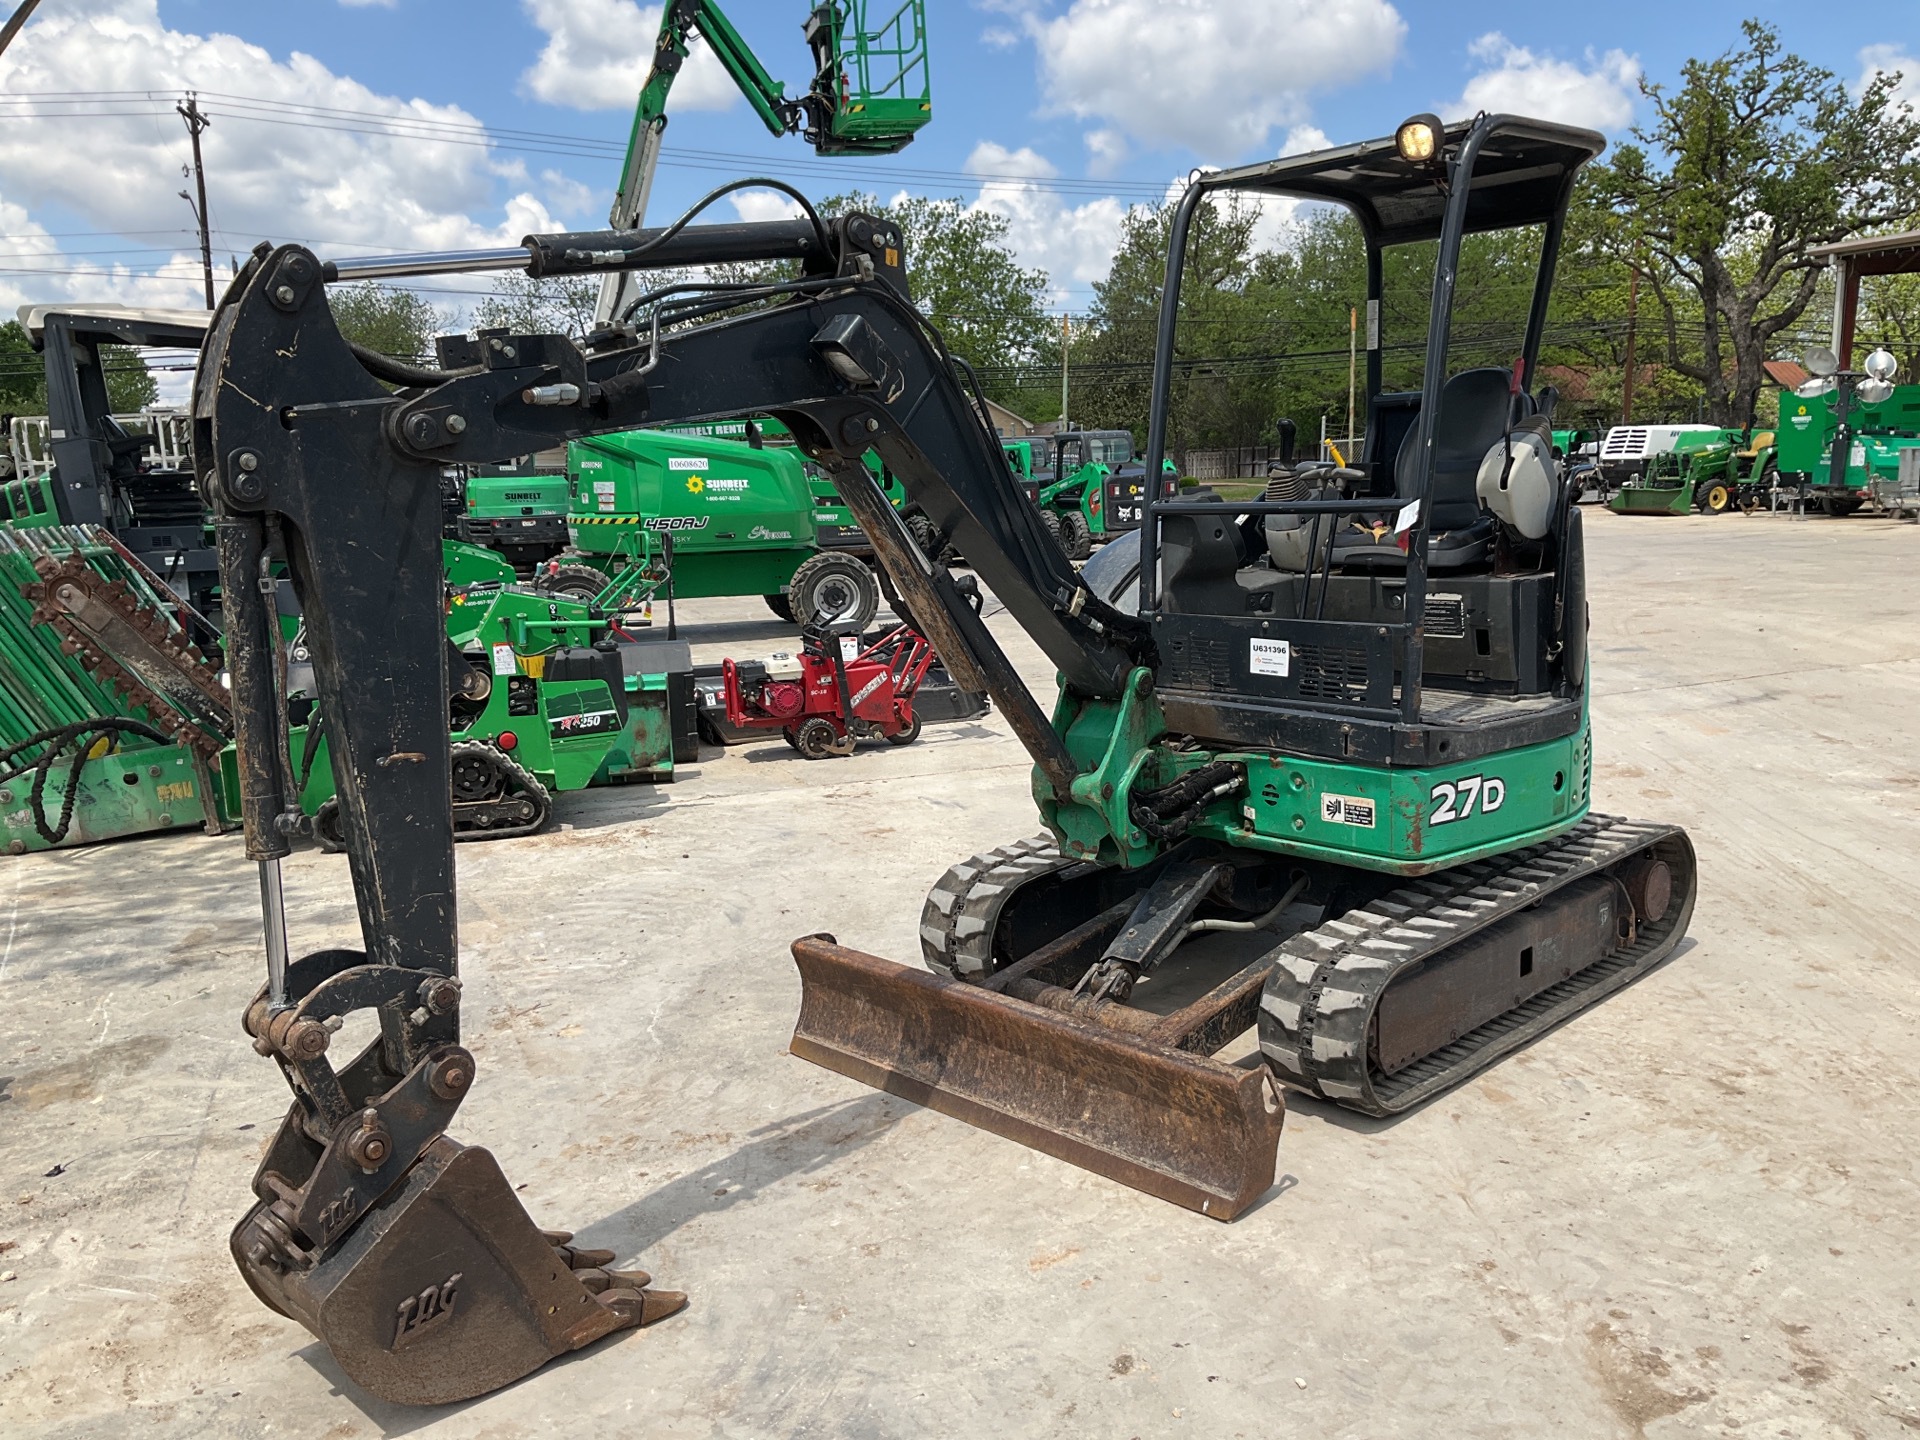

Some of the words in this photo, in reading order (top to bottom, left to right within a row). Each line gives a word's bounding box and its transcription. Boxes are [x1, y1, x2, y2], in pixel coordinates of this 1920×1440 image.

[670, 460, 708, 469] 10608620
[706, 479, 749, 488] SUNBELT
[505, 492, 541, 500] SUNBELT
[644, 516, 709, 531] 450AJ
[1252, 645, 1287, 655] U631396
[1428, 772, 1506, 828] 27D
